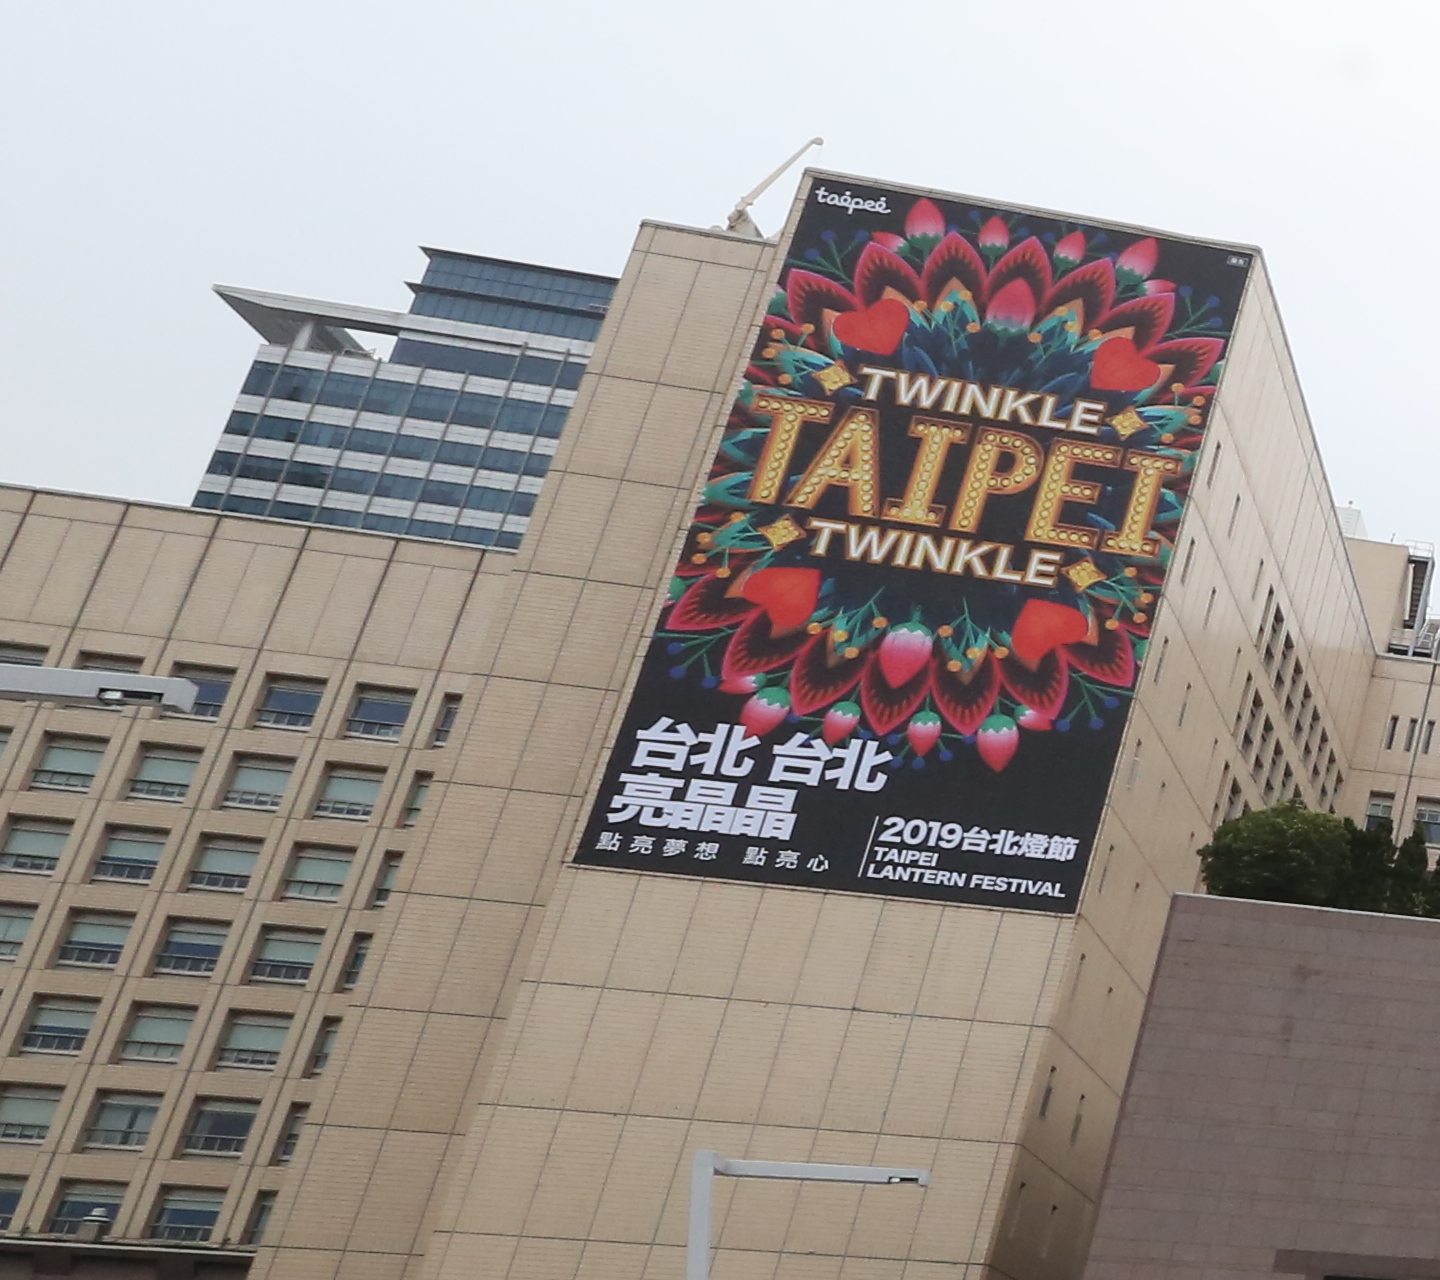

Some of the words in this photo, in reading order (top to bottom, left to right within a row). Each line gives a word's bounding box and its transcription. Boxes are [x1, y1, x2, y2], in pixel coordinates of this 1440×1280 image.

[857, 365, 1107, 436] TWINKLE
[748, 393, 1183, 560] TAIPEI
[806, 518, 1066, 588] TWINKLE
[631, 716, 761, 777] 台北
[768, 731, 894, 794] 台北
[606, 772, 798, 840] 亮晶晶
[878, 816, 1080, 862] 2019台北燈節
[595, 831, 720, 861] 點亮夢想
[742, 846, 829, 872] 點亮心
[867, 864, 967, 888] LANTERN
[969, 873, 1066, 898] FESTIVAL
[873, 846, 939, 867] TAIPEI
